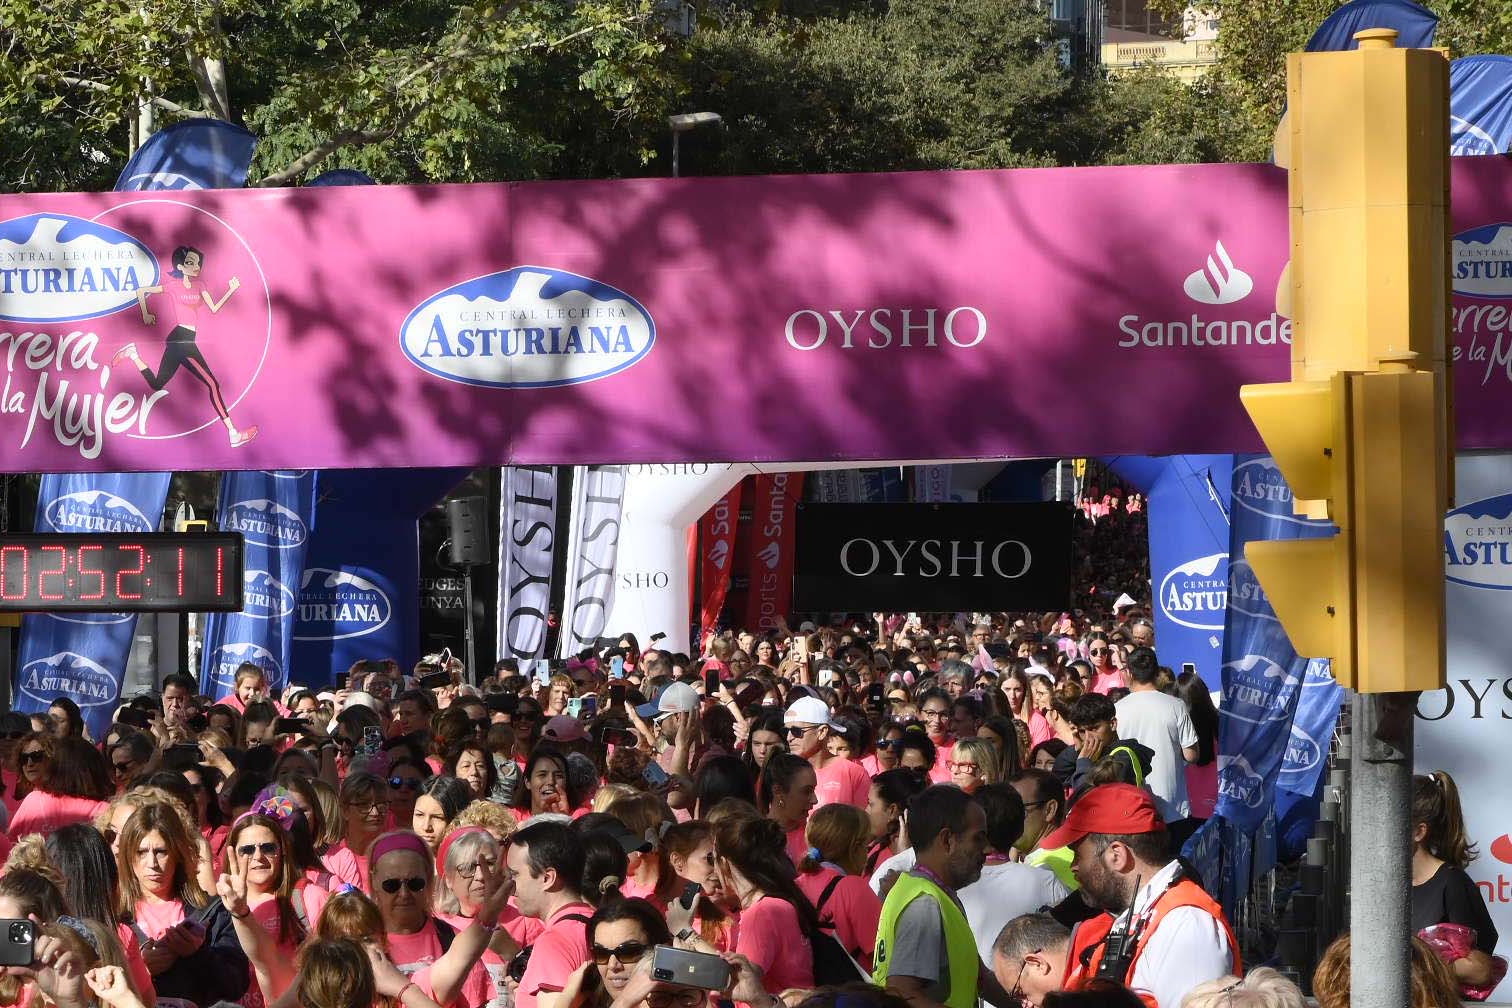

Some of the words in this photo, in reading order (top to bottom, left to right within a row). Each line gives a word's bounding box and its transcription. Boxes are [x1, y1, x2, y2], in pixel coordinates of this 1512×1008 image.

[62, 249, 135, 261] LECHERA
[459, 310, 541, 322] CENTRAL
[546, 307, 628, 319] LECHERA
[784, 306, 988, 351] OYSHO
[1119, 312, 1292, 349] Santande
[420, 313, 636, 358] ASTURIANA
[0, 377, 25, 414] la
[20, 366, 170, 460] Mujer
[54, 504, 144, 532] ASTURIANA
[0, 545, 225, 600] 02:52:11
[507, 466, 554, 660] OYSH
[571, 466, 624, 646] OYSH
[839, 538, 1033, 579] OYSHO
[617, 571, 669, 589] SHO
[1183, 580, 1226, 589] CENTRA
[296, 602, 382, 622] URIANA
[760, 573, 777, 630] ports
[25, 669, 109, 700] ASTURIANA
